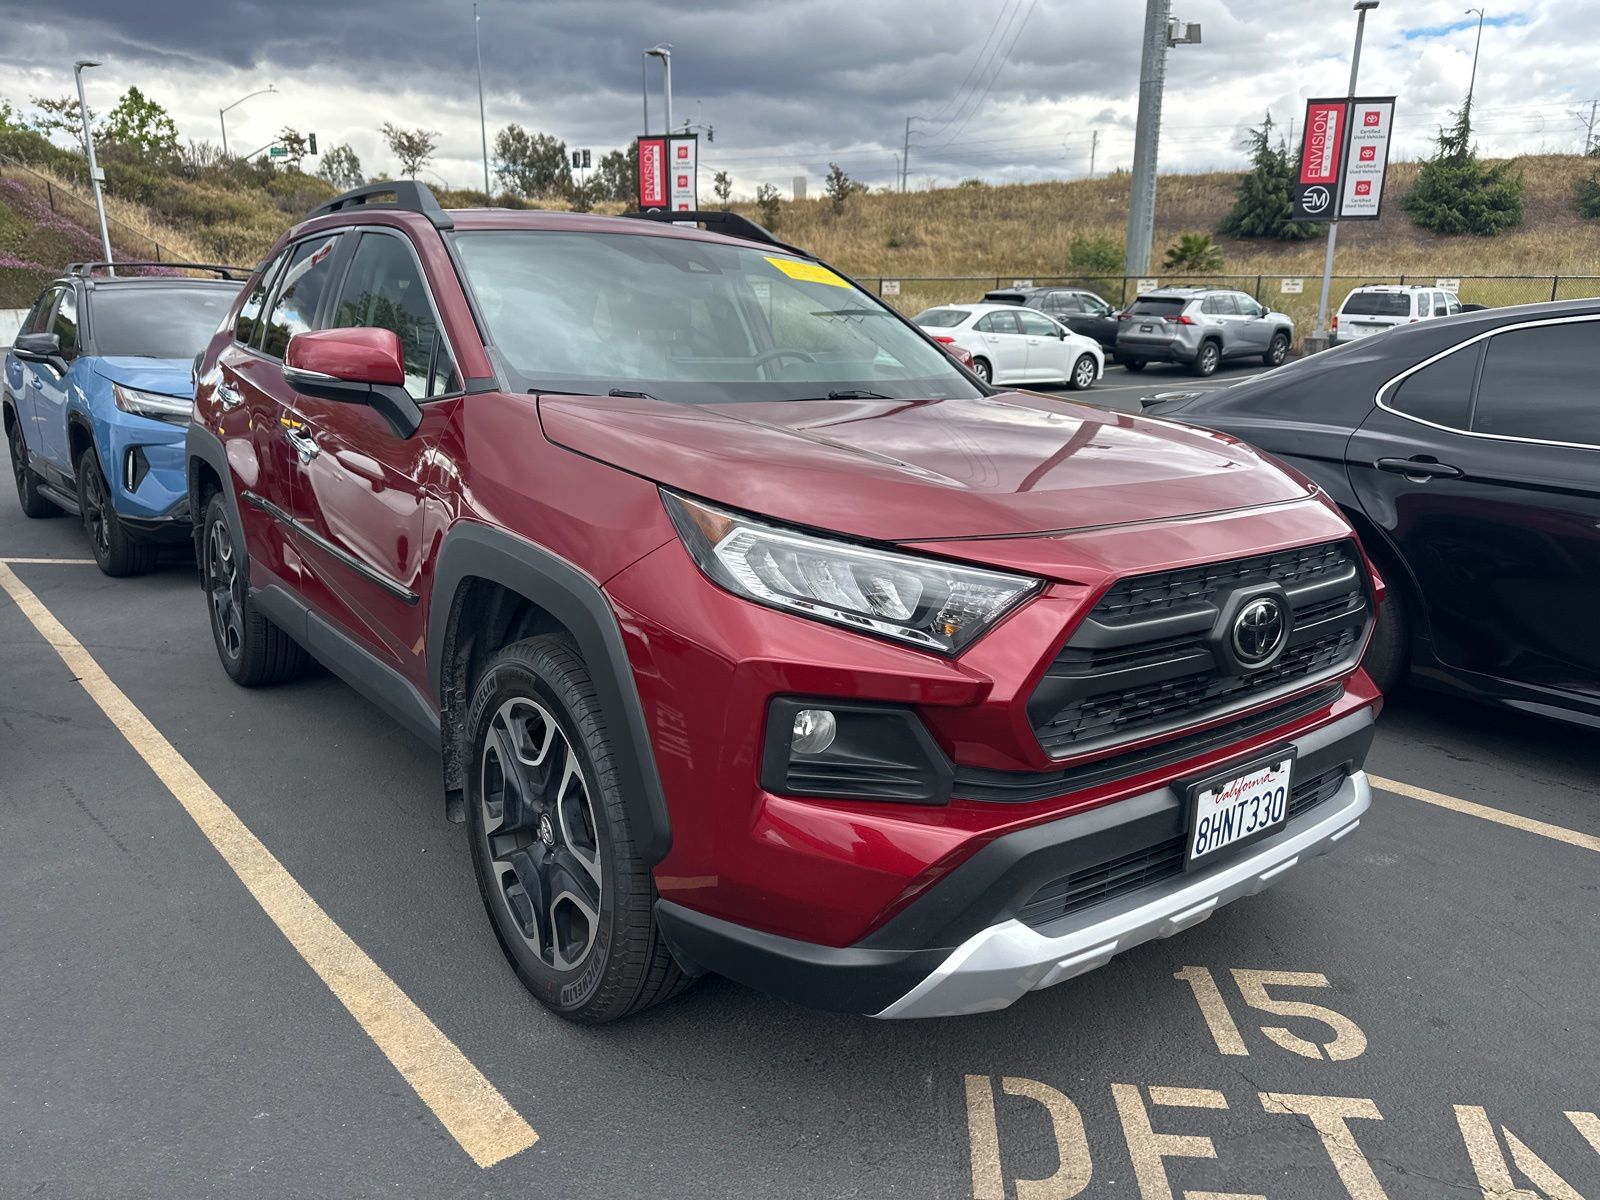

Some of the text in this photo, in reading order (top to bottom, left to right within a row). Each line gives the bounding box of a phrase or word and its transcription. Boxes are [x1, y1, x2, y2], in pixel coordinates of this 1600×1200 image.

[643, 145, 654, 201] ENVISION
[1307, 110, 1327, 178] ENVISION
[468, 676, 496, 739] MICHELIN
[1215, 772, 1276, 804] California
[1195, 786, 1285, 854] 8HNT330
[562, 952, 601, 1003] MICHELIN
[1173, 965, 1368, 1062] 15
